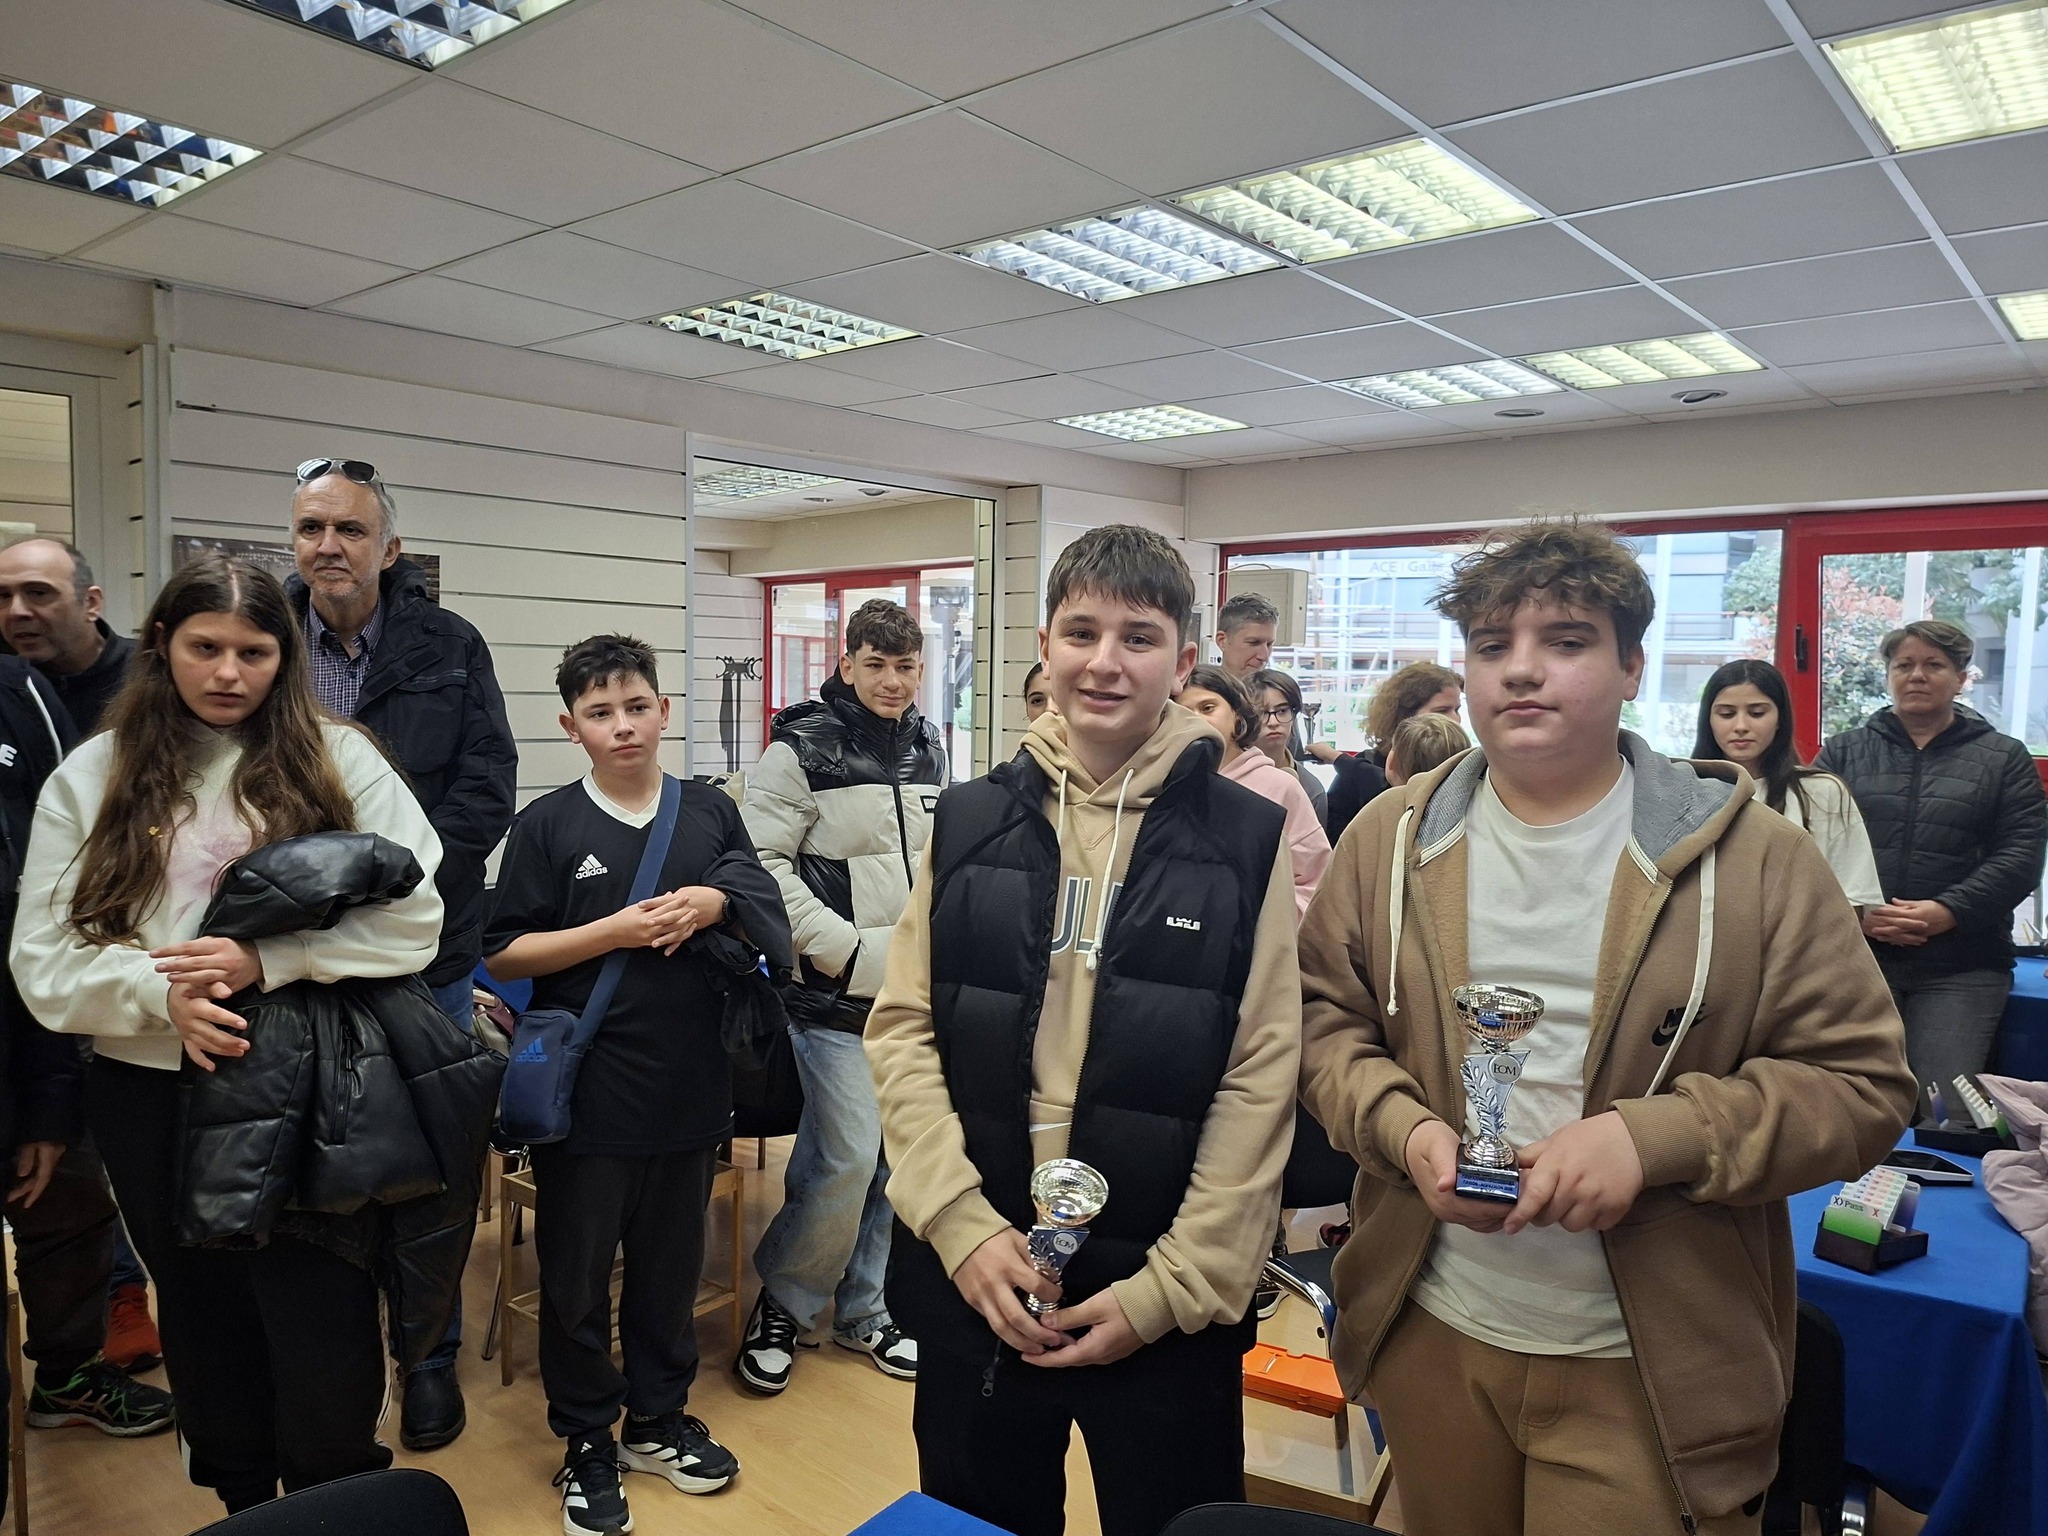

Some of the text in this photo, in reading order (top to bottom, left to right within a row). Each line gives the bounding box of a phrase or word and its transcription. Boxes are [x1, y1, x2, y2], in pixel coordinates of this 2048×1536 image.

[1370, 561, 1397, 573] ACE
[575, 866, 608, 880] adidas
[1844, 1200, 1864, 1212] Pass
